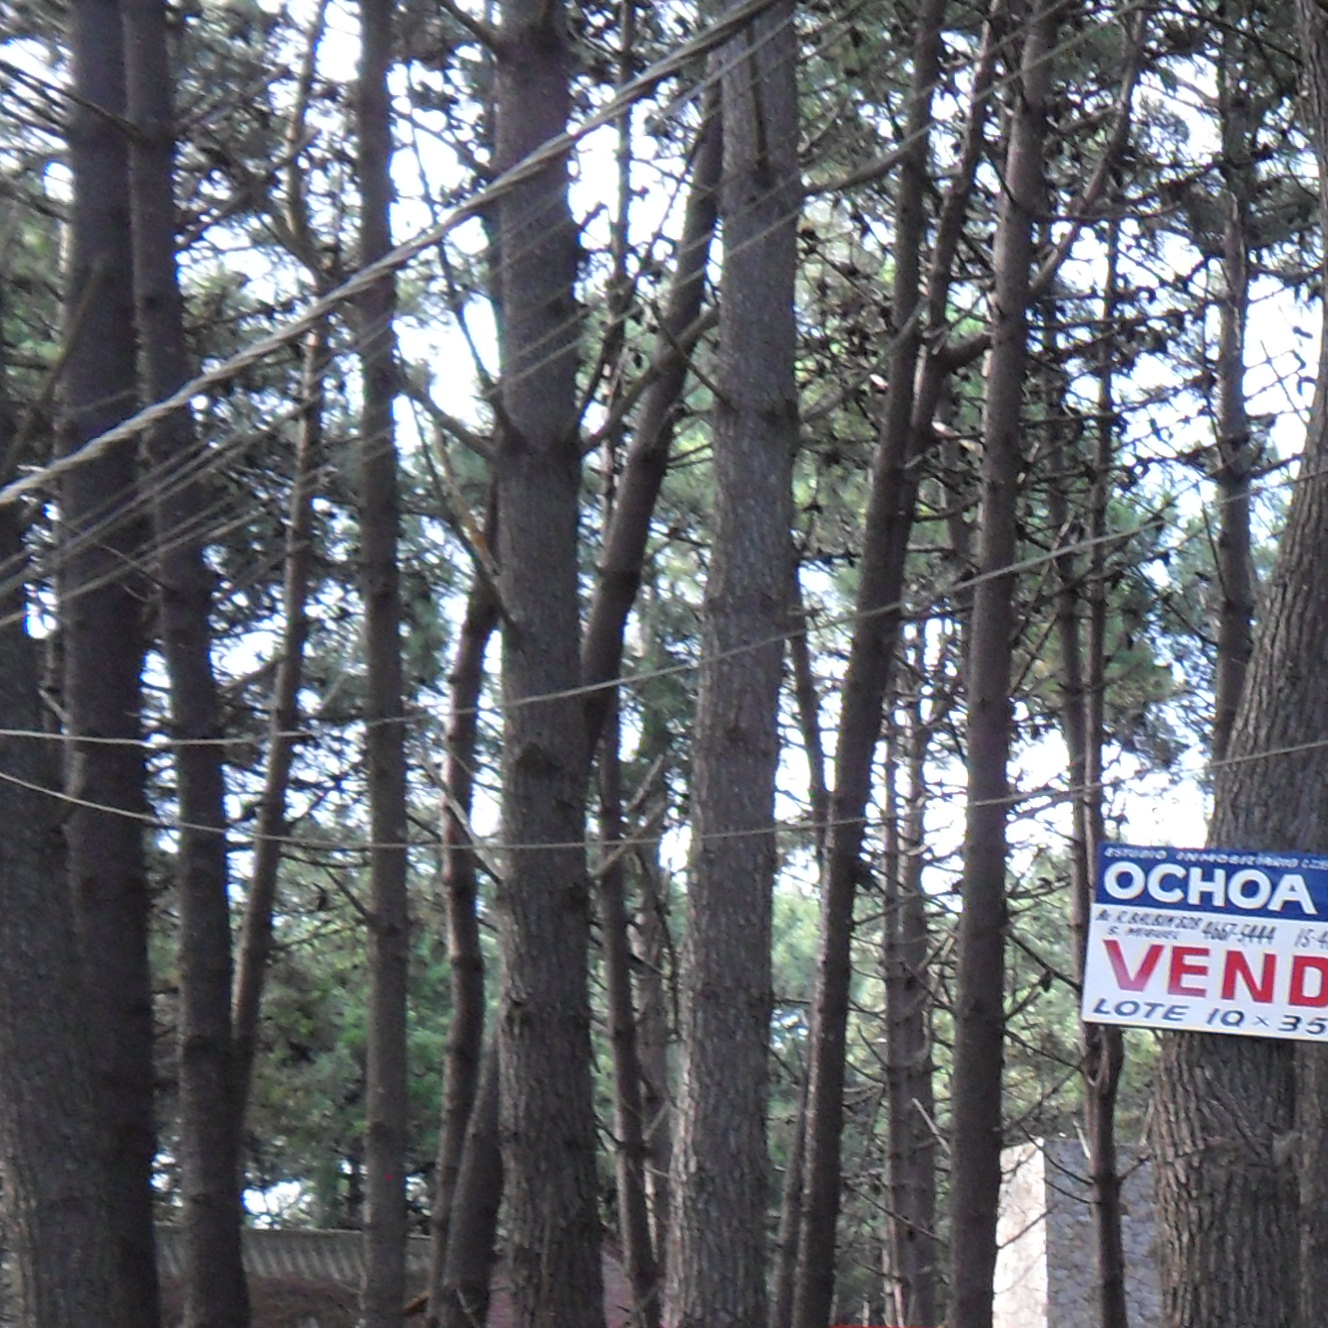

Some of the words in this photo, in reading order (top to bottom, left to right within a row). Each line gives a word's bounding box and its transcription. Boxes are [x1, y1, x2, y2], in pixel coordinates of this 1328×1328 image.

[1103, 861, 1317, 914] OCHOA
[1092, 997, 1190, 1022] LOTE
[1205, 1007, 1245, 1028] 10
